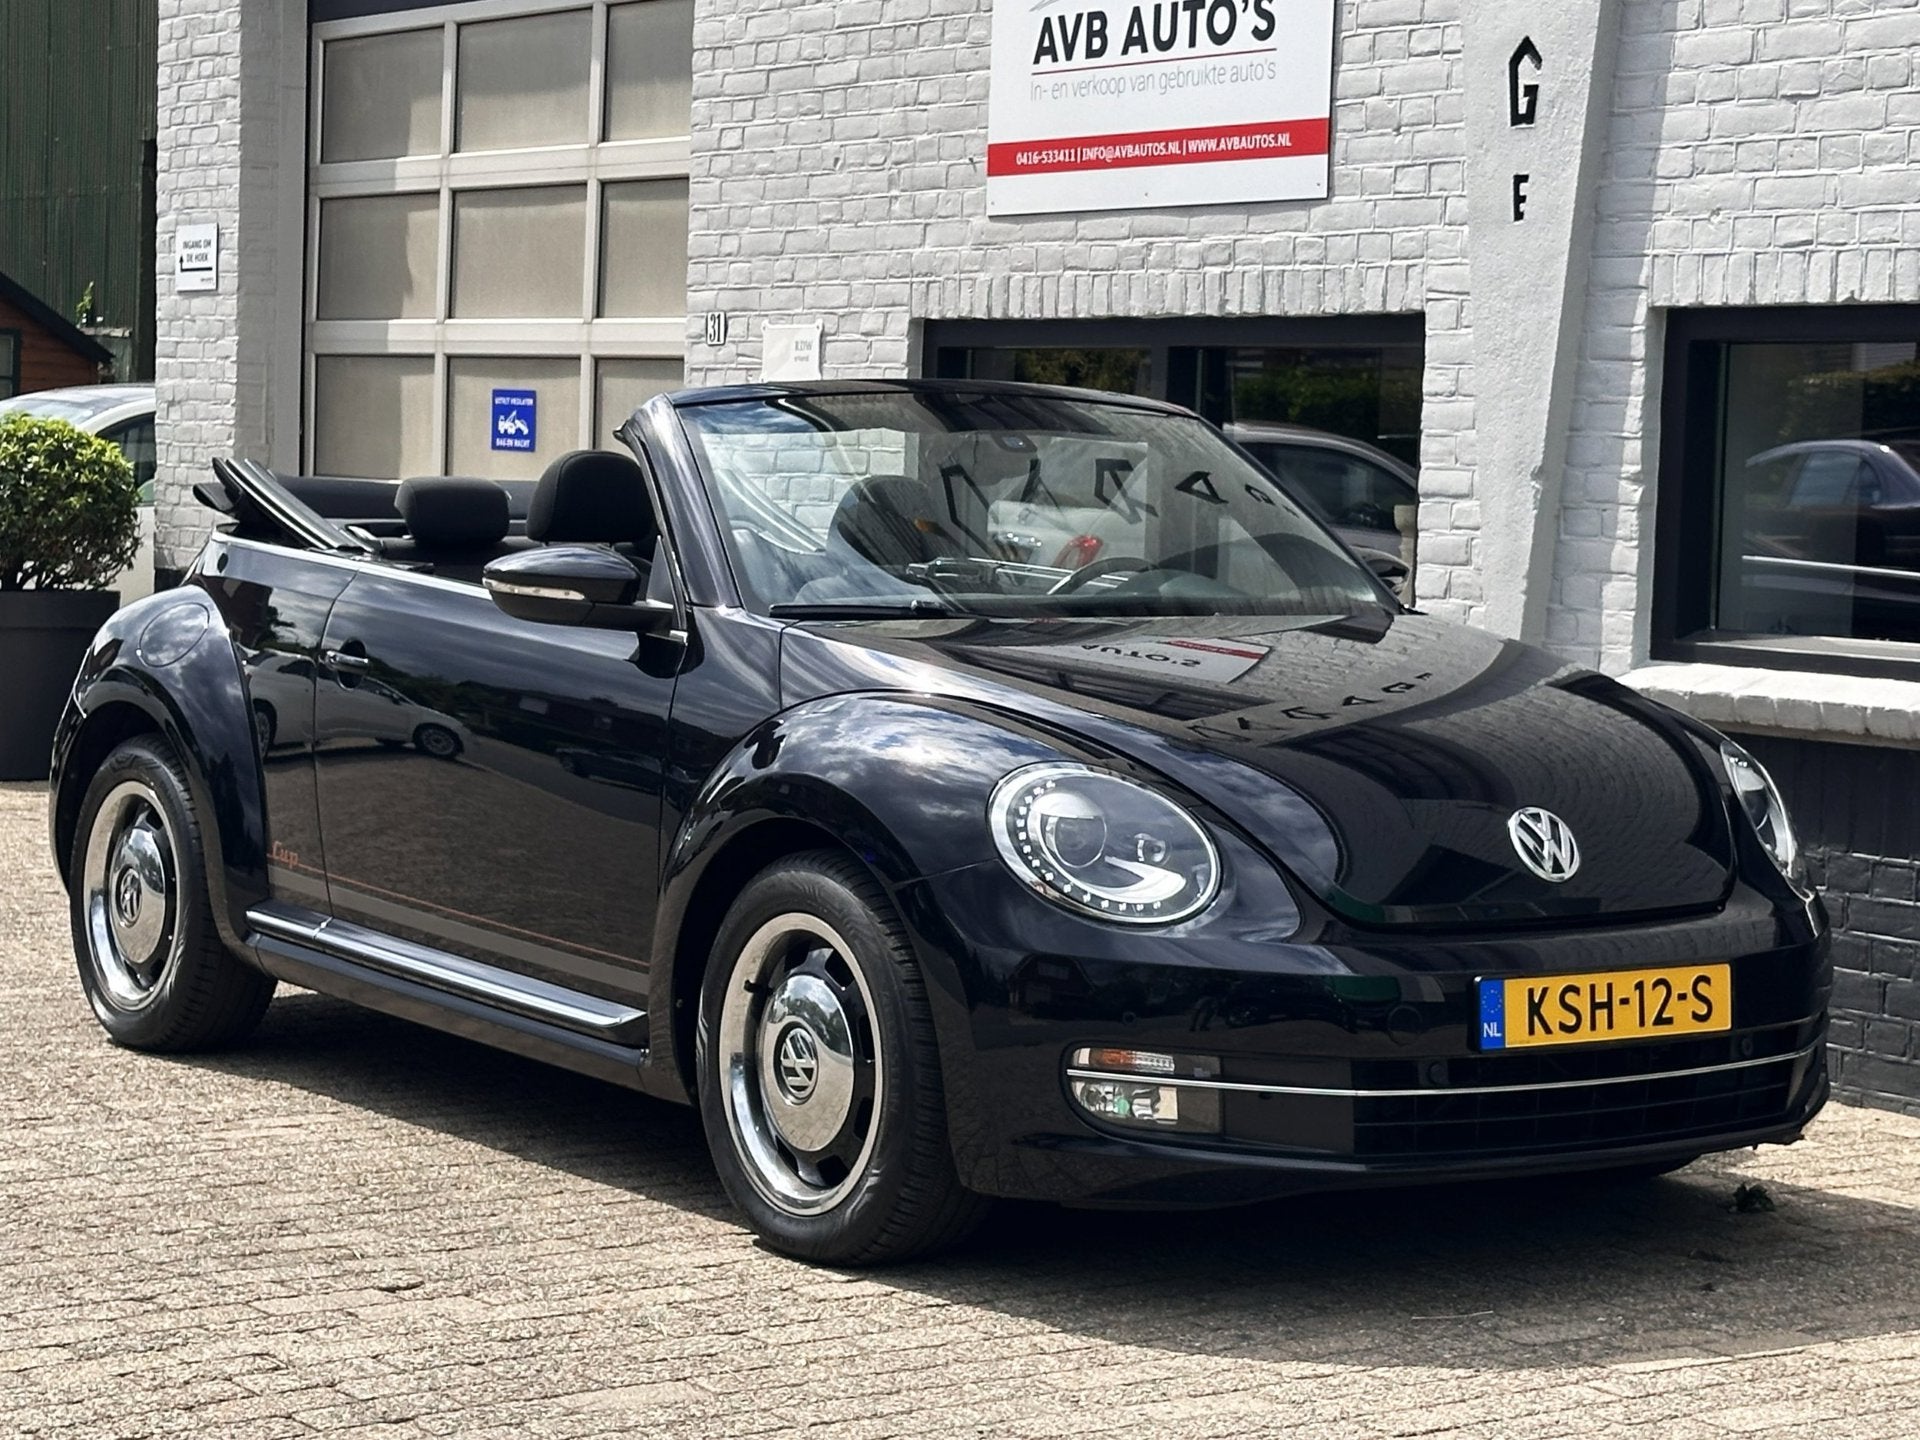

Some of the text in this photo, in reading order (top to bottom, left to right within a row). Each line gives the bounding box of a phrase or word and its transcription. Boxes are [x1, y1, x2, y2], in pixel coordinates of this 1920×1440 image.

[1033, 0, 1276, 65] AVB AUTO'S
[1051, 82, 1068, 99] en
[1071, 75, 1126, 98] verkoop
[1130, 73, 1155, 92] van
[1159, 63, 1226, 95] gebruikte
[1230, 59, 1276, 84] auto's
[1187, 132, 1292, 153] WWW.AVBAUTOS.NL
[709, 313, 721, 343] 31
[1527, 975, 1713, 1036] KSH-12-S
[1484, 1022, 1502, 1037] NL
